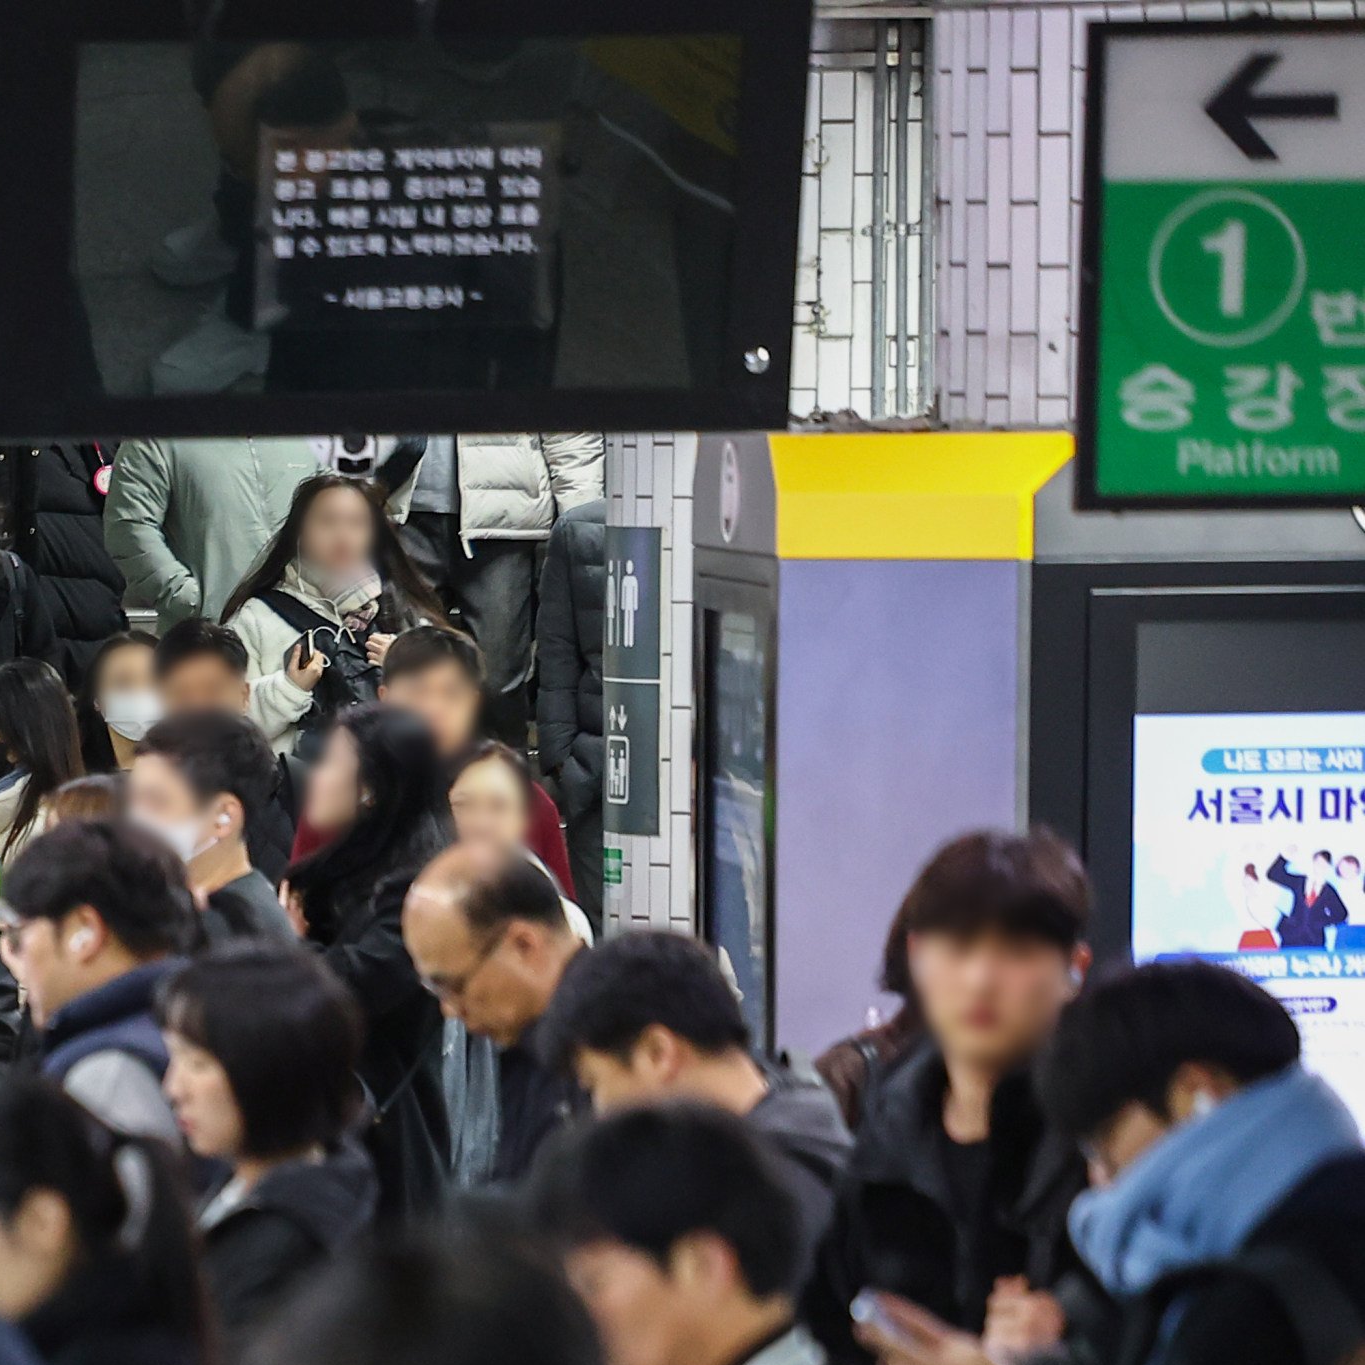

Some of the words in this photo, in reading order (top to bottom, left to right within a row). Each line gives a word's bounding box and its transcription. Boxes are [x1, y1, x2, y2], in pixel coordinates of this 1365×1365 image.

[1200, 218, 1246, 318] 1
[1177, 438, 1340, 478] Platform
[1188, 786, 1304, 824] 서울시
[1319, 786, 1365, 824] 마
